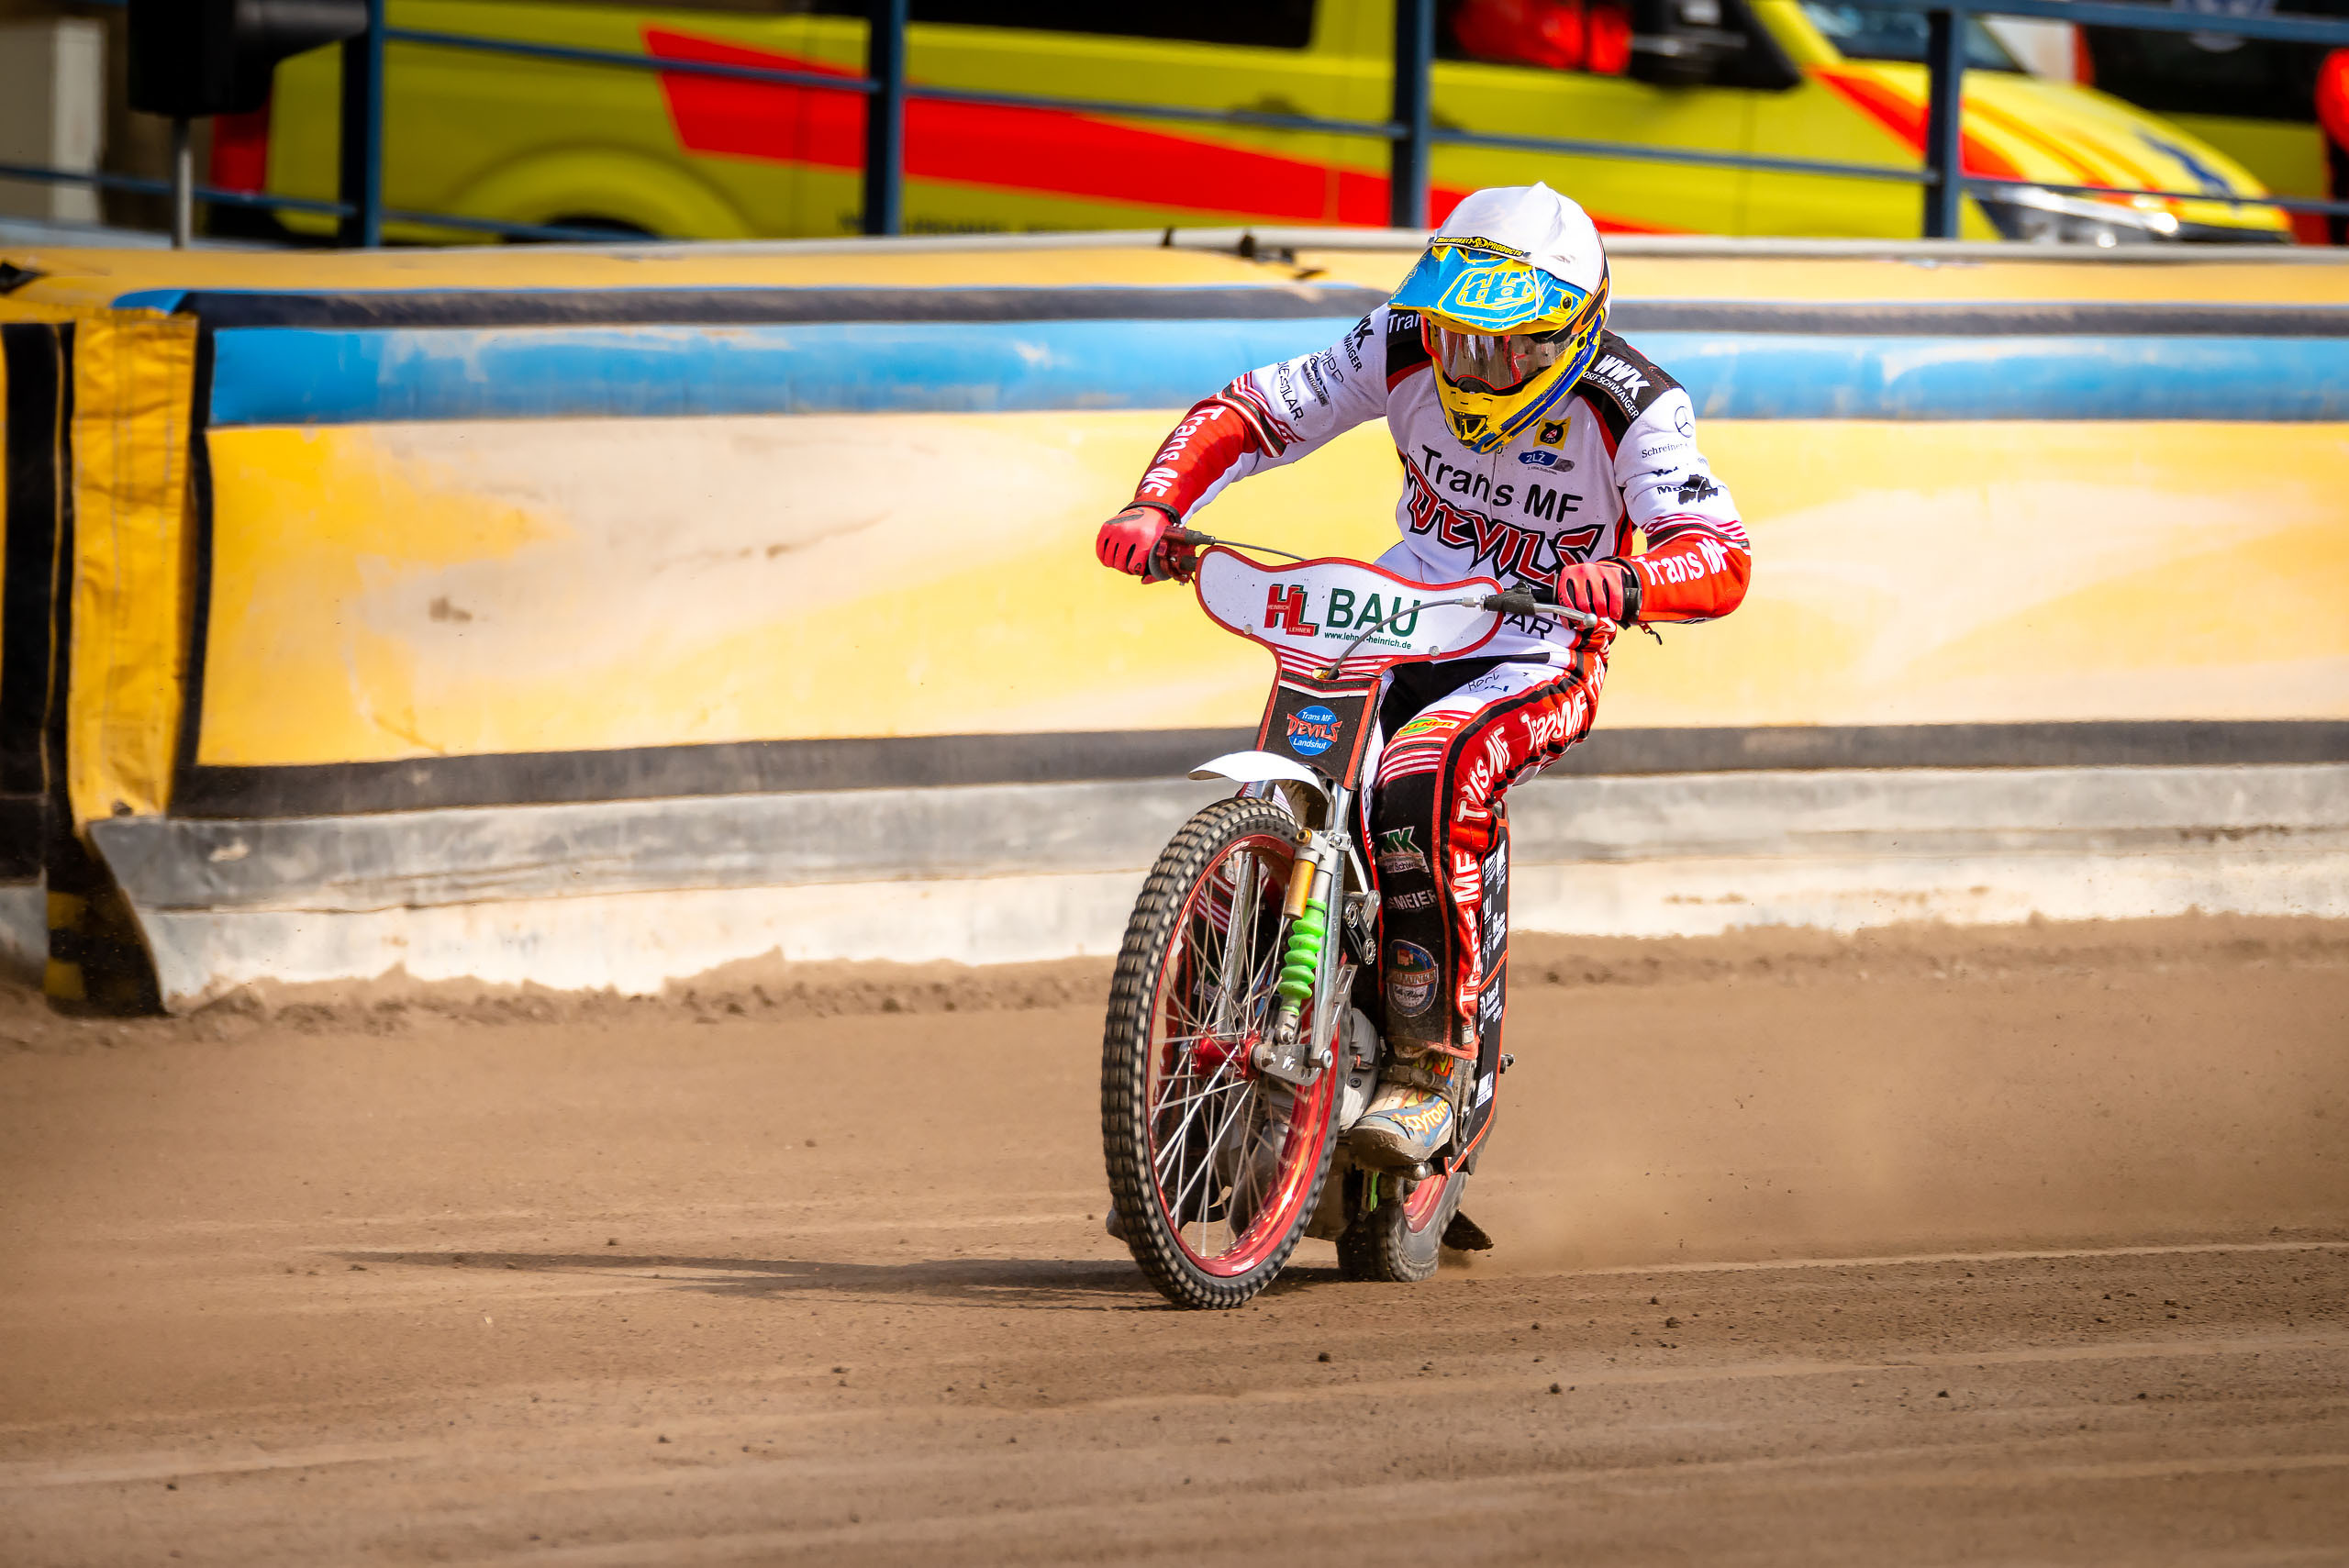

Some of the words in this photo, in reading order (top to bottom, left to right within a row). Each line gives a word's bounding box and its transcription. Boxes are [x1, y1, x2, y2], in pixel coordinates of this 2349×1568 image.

[1582, 371, 1601, 381] OSEF
[1597, 375, 1640, 418] SCHWAIGER
[1593, 354, 1651, 401] WWK
[1156, 405, 1227, 464] Trans
[1141, 467, 1178, 497] MF
[1421, 444, 1515, 506] Trans
[1523, 484, 1584, 523] MF
[1406, 452, 1606, 589] DEVILS
[1631, 551, 1705, 587] Trans
[1326, 587, 1421, 638] BAU
[1504, 613, 1554, 640] AR
[1324, 630, 1412, 650] www.lehnr-heinrich.de
[1286, 713, 1343, 743] DEVILS
[1302, 712, 1319, 721] Trans
[1321, 714, 1332, 722] MF
[1293, 738, 1327, 749] Landshut
[1454, 851, 1480, 904] MF
[1459, 906, 1481, 1014] Trans
